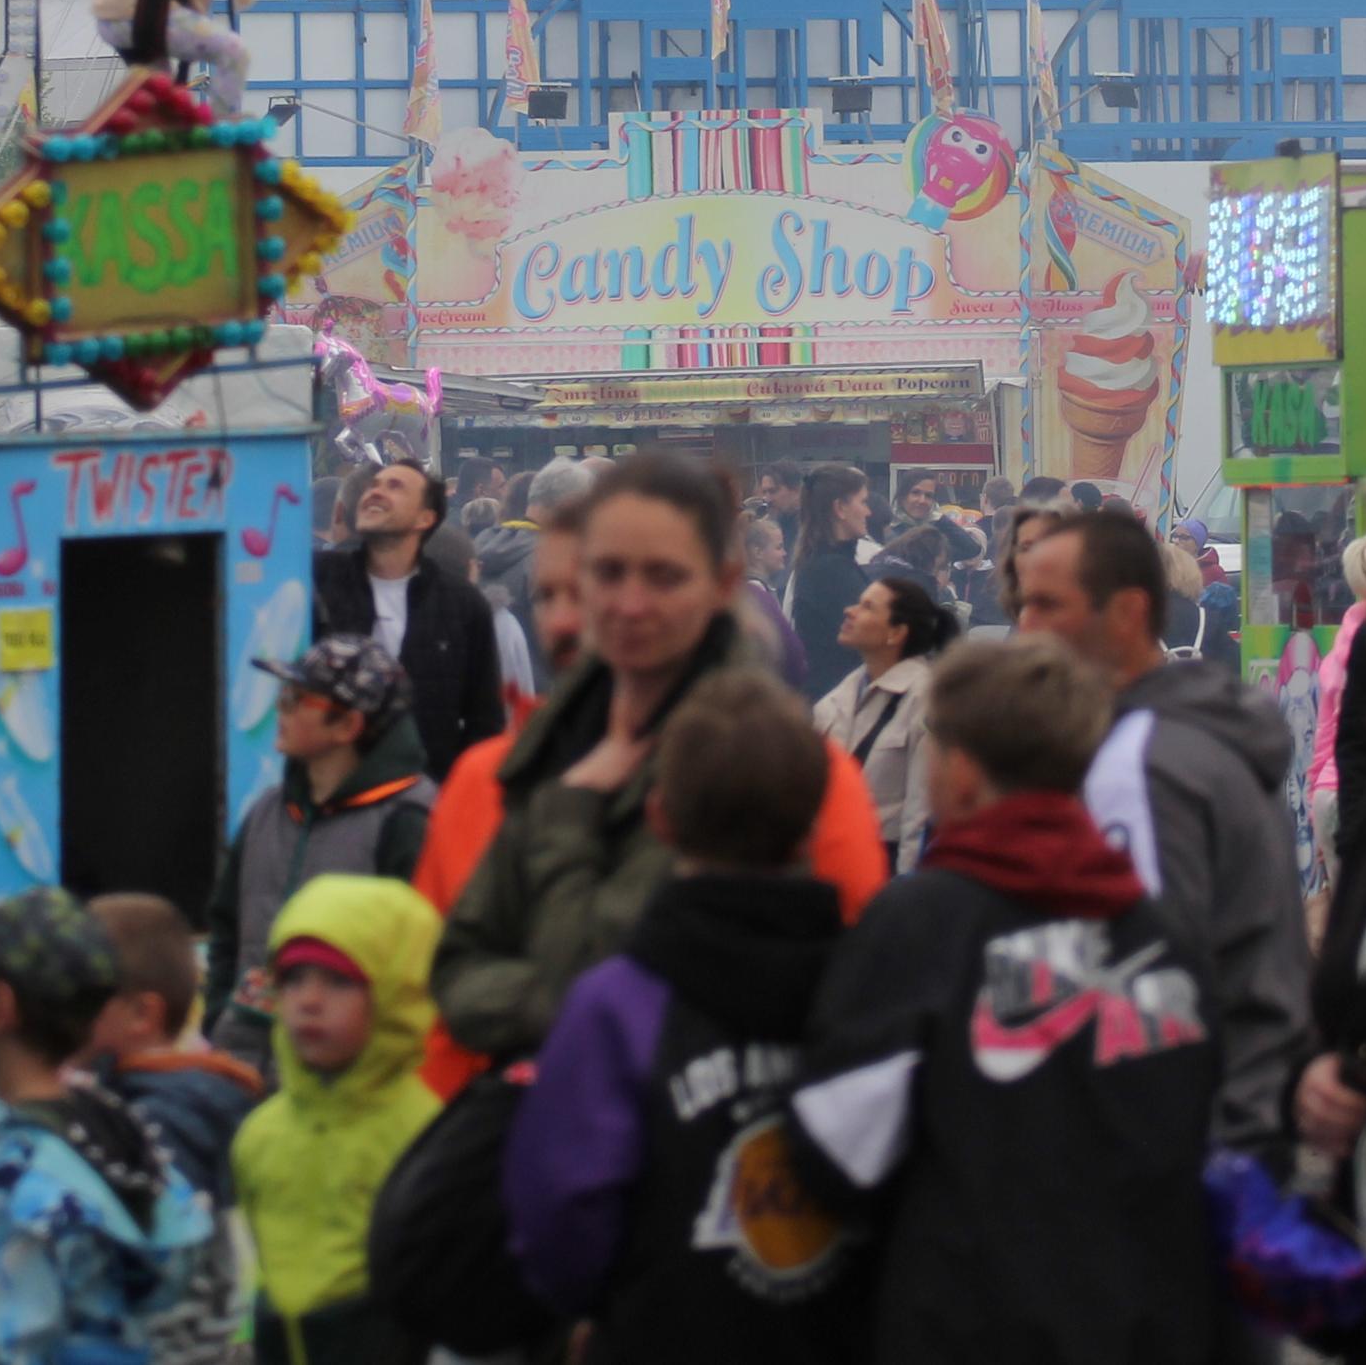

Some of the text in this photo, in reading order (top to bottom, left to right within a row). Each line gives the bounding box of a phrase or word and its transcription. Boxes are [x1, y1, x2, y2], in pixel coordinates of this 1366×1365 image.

[59, 178, 239, 294] KASSA
[1057, 199, 1157, 260] PREMIUM
[512, 208, 936, 321] Candy Shop
[950, 298, 994, 316] Sweet
[546, 386, 639, 404] Zmrzlina
[746, 379, 826, 398] Cukrová
[832, 377, 884, 394] Vata
[896, 376, 972, 394] Popcorn
[52, 447, 234, 529] TWISTER
[937, 471, 980, 487] corn
